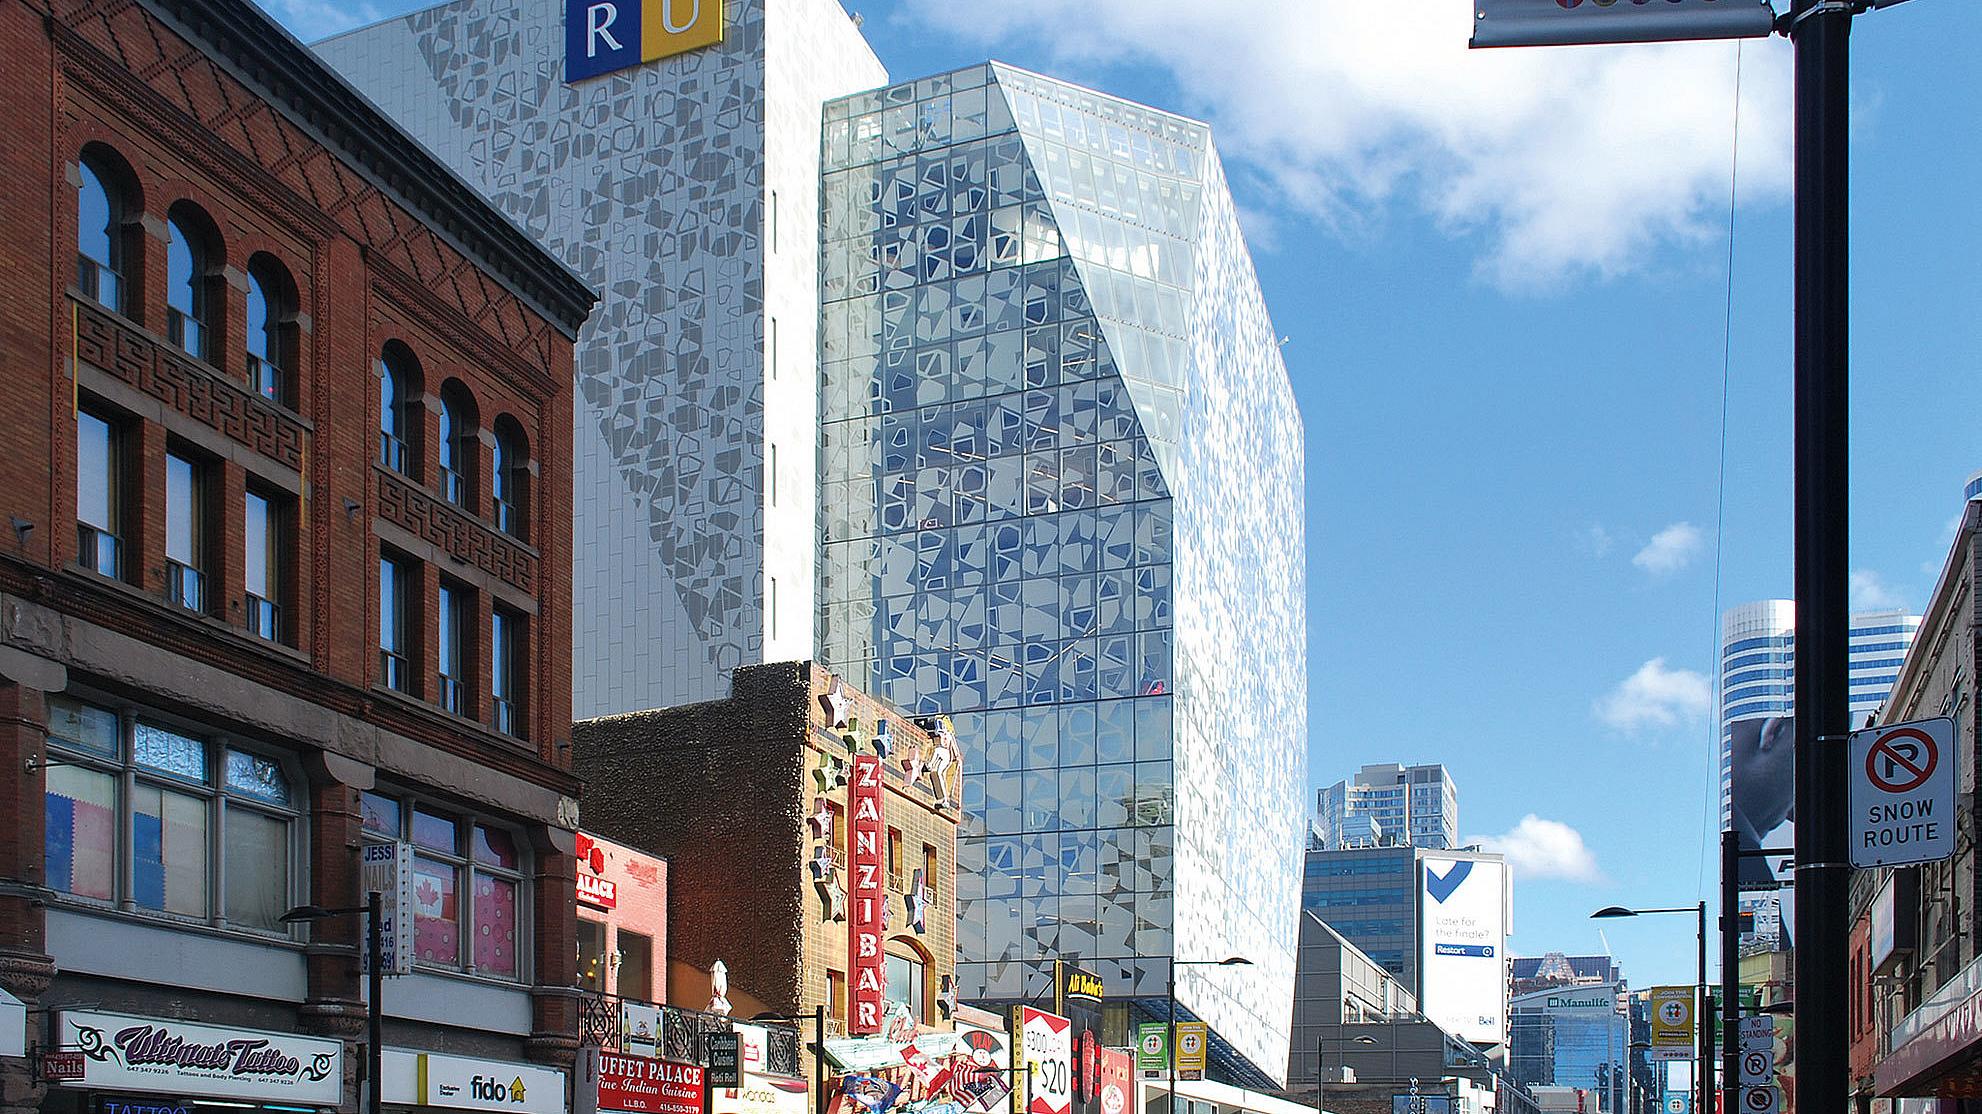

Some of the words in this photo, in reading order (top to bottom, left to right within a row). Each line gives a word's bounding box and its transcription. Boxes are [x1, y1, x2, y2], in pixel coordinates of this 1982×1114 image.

[1869, 799, 1933, 824] SNOW
[1864, 823, 1939, 848] ROUTE
[365, 846, 395, 861] JESSI
[364, 863, 396, 891] NAILS
[576, 873, 613, 899] ALACE
[856, 763, 879, 1027] ZANZIBAR
[1461, 916, 1476, 926] for
[1436, 929, 1452, 937] the
[1437, 946, 1466, 955] Restart
[1068, 974, 1080, 993] Ali
[1081, 976, 1104, 998] Baba's
[1560, 998, 1609, 1008] Manulife
[1478, 1016, 1495, 1026] Bell
[1751, 1019, 1762, 1028] NO
[1741, 1029, 1772, 1039] STANDING
[114, 1025, 231, 1071] Ultimate
[225, 1039, 300, 1077] Tattoo
[713, 1052, 734, 1066] Cuisine
[47, 1060, 83, 1073] Nails
[599, 1056, 644, 1078] UFFET
[649, 1062, 701, 1085] PALACE
[1042, 1058, 1066, 1095] $20
[470, 1075, 506, 1101] fido
[621, 1078, 658, 1095] Indian
[662, 1082, 697, 1099] Cuisine
